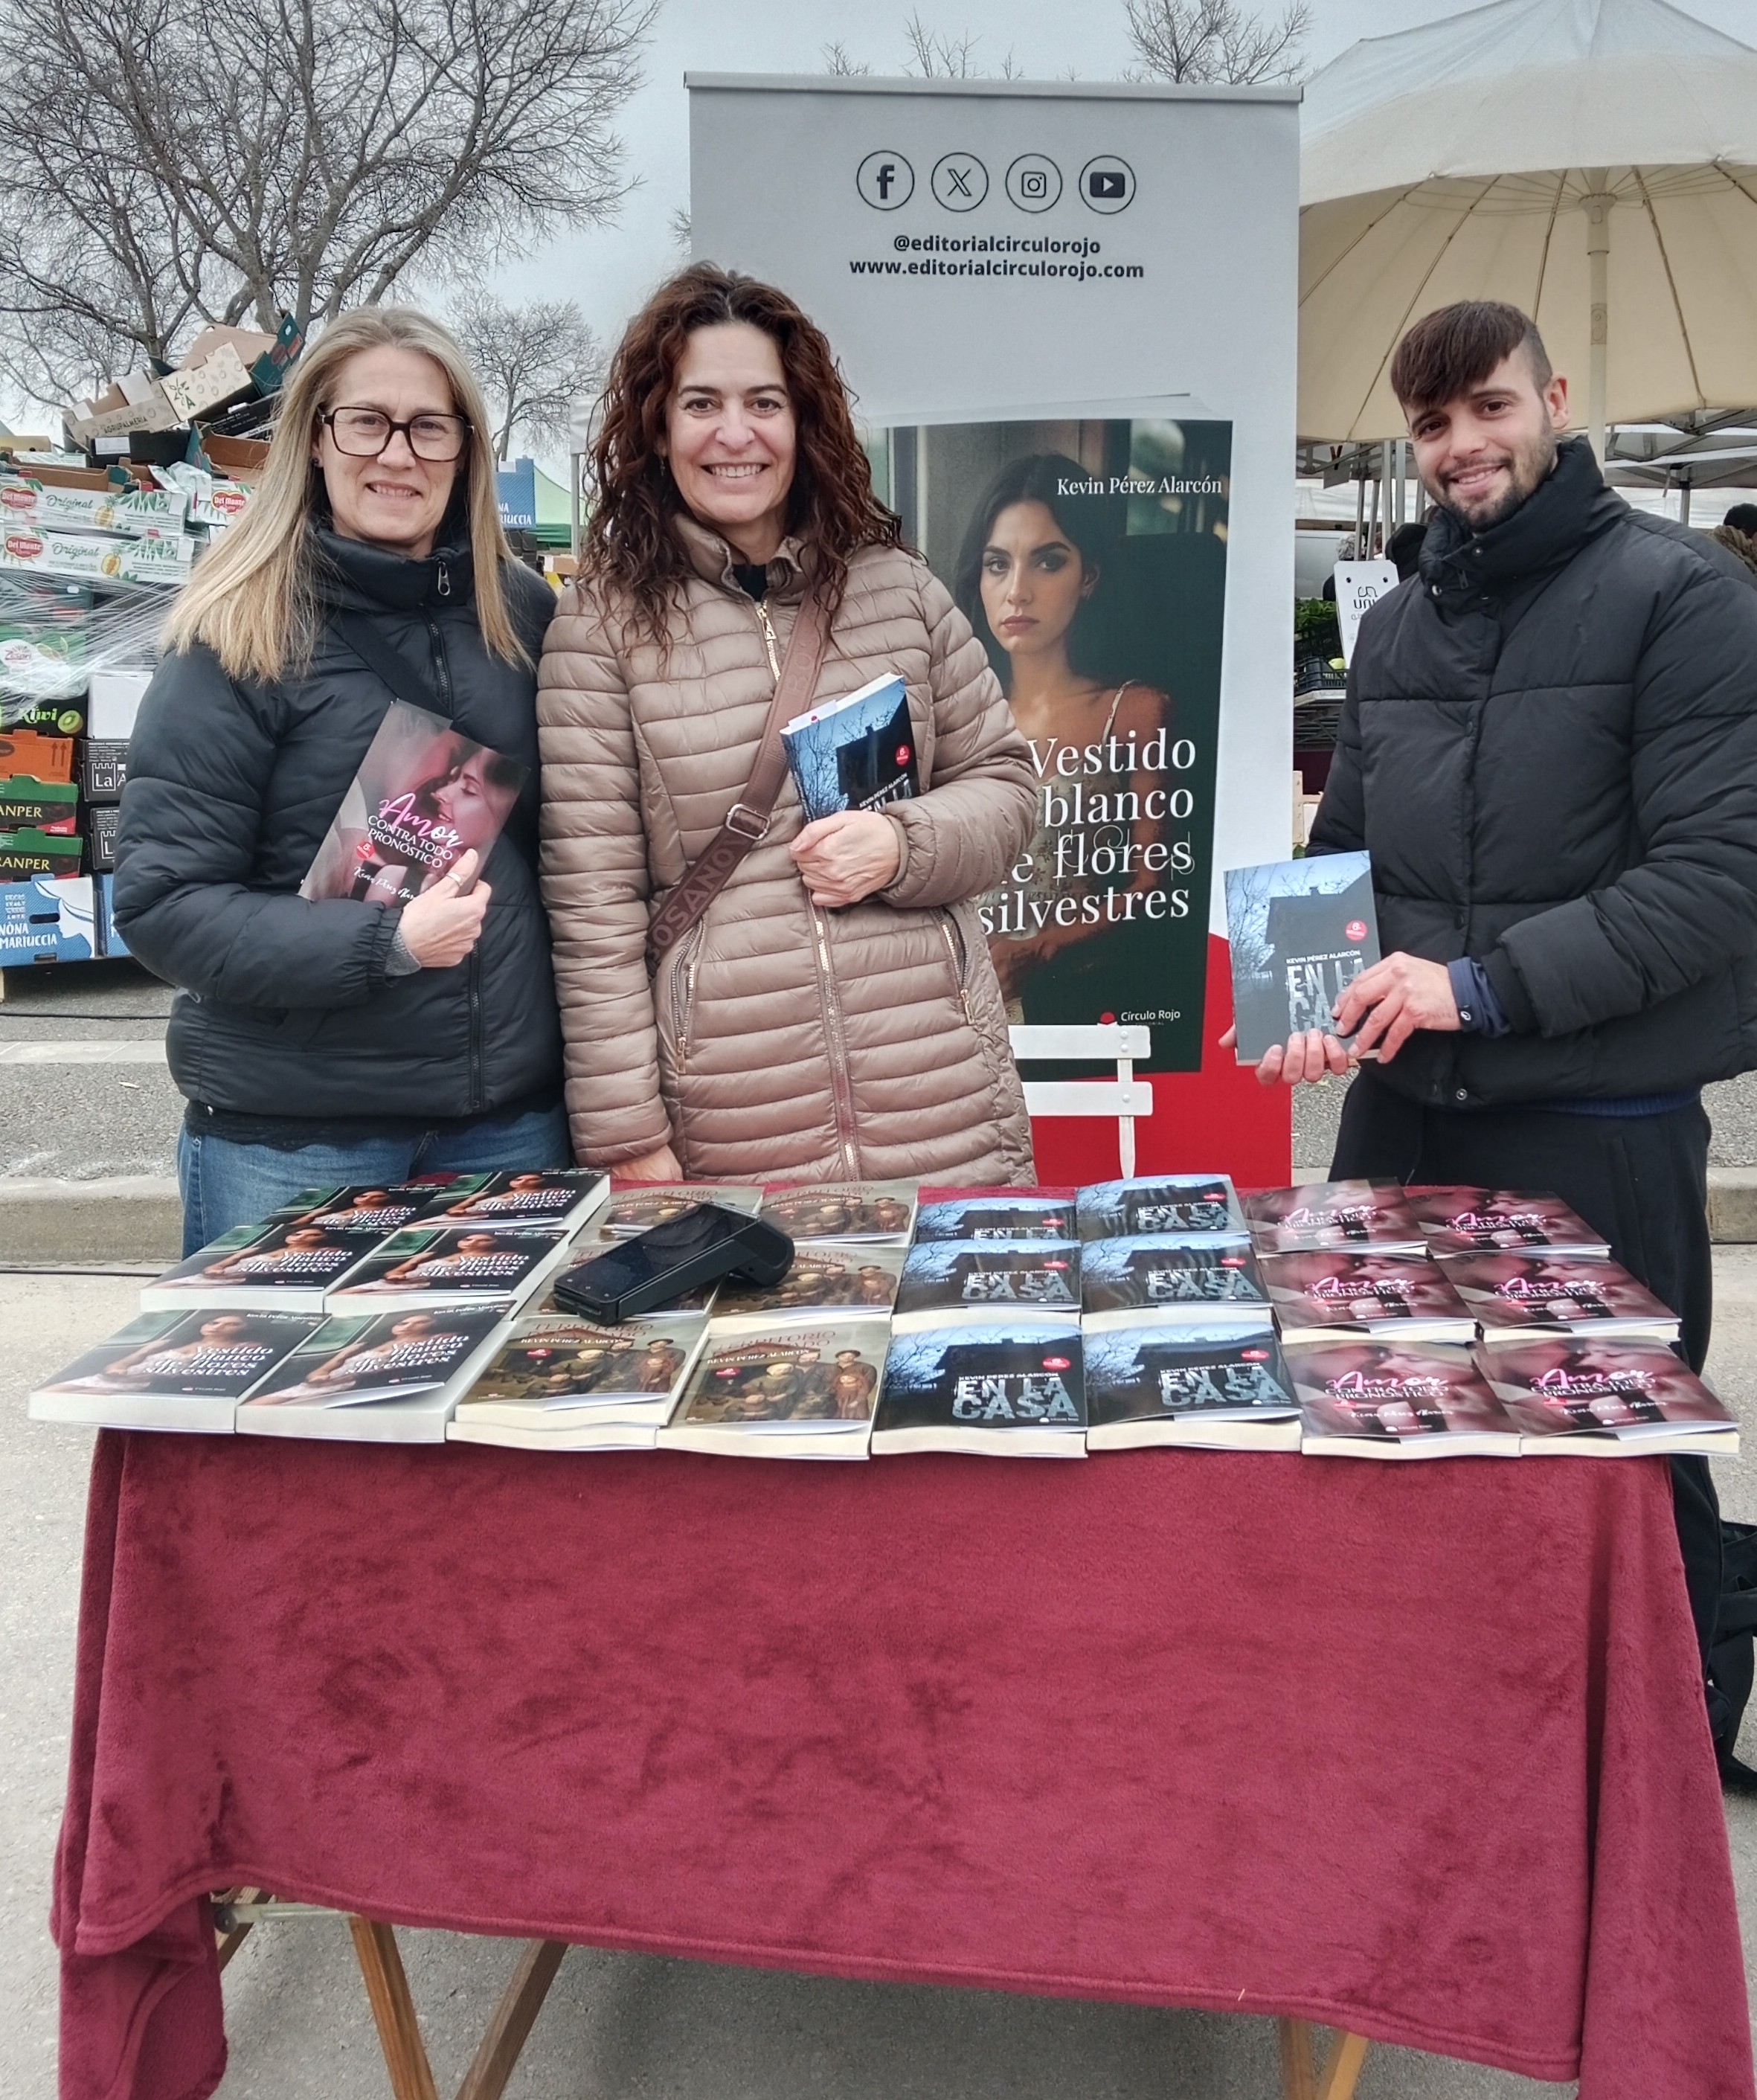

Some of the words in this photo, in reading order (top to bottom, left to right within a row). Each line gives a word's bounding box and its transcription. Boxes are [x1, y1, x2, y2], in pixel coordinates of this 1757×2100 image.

[893, 235, 1101, 257] @editorialcirculorojo
[849, 259, 1144, 281] www.editorialcirculorojo.com
[1057, 477, 1105, 495] Kevin
[1109, 475, 1155, 494] Pérez
[1157, 475, 1222, 493] Alarcón
[45, 495, 94, 512] Original
[214, 496, 225, 504] Del
[19, 542, 42, 550] Monte
[52, 542, 100, 559] Original
[1027, 728, 1196, 778] Vestido
[95, 773, 113, 787] La
[1042, 783, 1193, 828] blanco
[379, 792, 463, 848] Amor
[367, 815, 417, 845] CONTRA
[420, 838, 453, 861] TODO
[367, 829, 443, 869] PRONÓSTICO
[1053, 832, 1192, 880] flores
[978, 887, 1189, 935] silvestres
[1287, 963, 1324, 998] EN
[1120, 1010, 1156, 1021] Círculo
[1158, 1009, 1181, 1021] Rojo
[1326, 1371, 1449, 1393] Amor
[1529, 1368, 1654, 1390] Amor
[1161, 1378, 1291, 1407] CASA
[951, 1390, 1079, 1420] CASA
